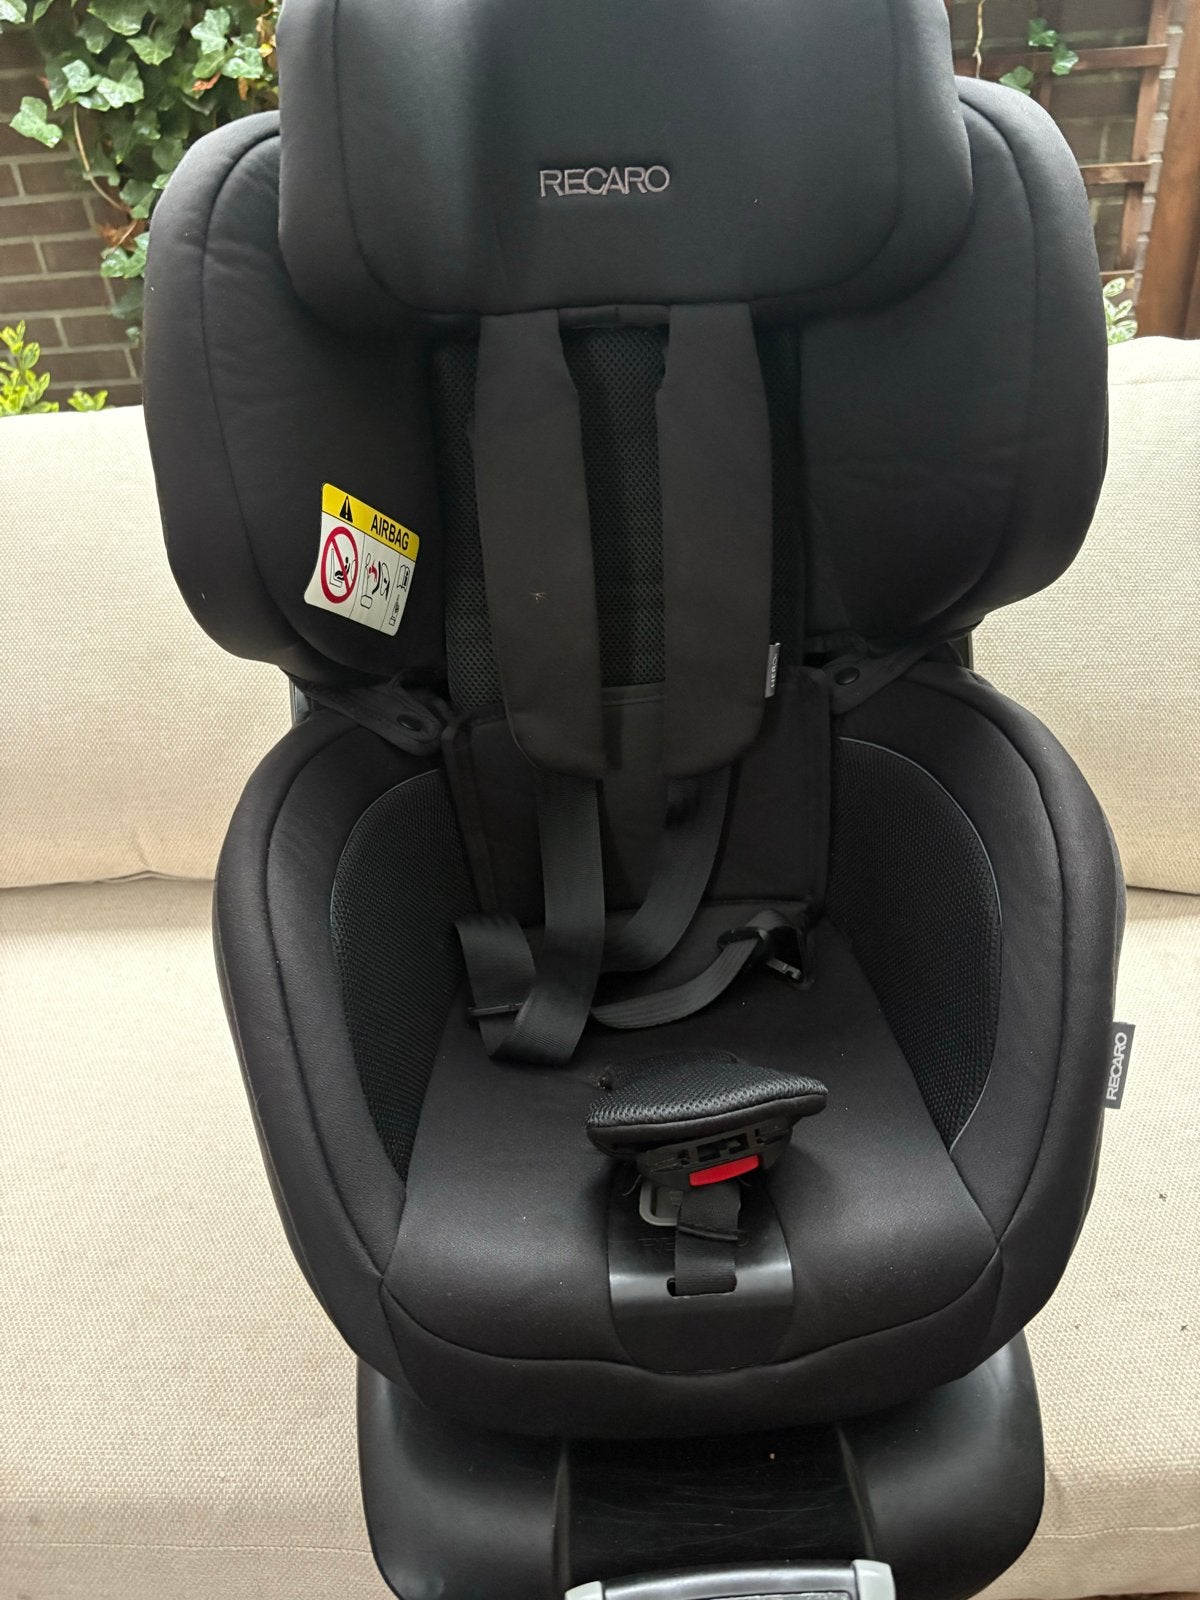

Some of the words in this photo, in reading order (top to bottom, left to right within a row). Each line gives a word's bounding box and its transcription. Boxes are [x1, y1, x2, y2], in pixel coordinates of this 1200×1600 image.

[540, 165, 671, 198] RECARO
[370, 514, 410, 551] AIRBAG
[1106, 1032, 1127, 1100] RECARO
